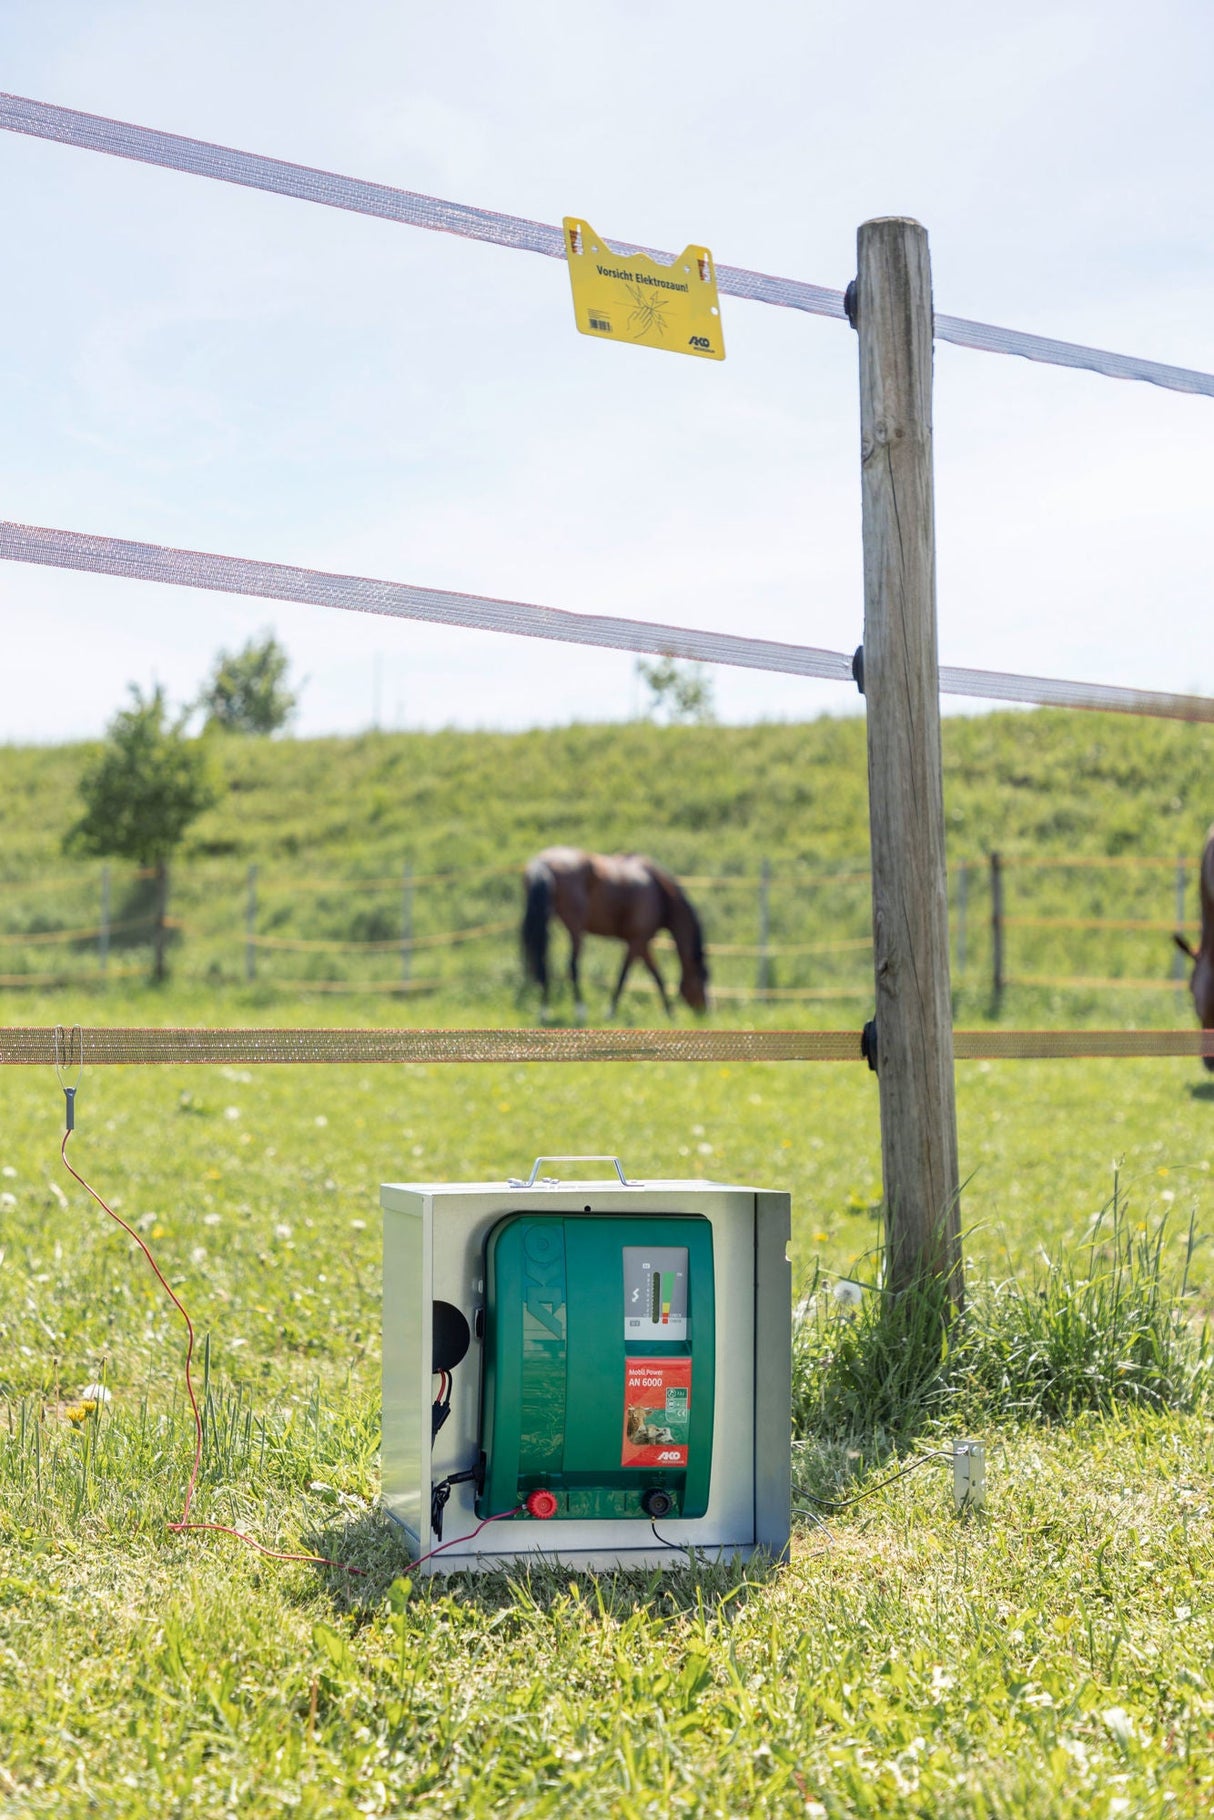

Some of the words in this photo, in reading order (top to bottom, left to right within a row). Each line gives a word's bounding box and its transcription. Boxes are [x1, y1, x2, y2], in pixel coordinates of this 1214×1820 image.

[596, 265, 633, 281] Vorsicht
[635, 273, 689, 293] Elektrozaun!
[688, 336, 710, 348] AKO
[524, 1223, 562, 1340] AKO
[629, 1378, 641, 1387] AN
[642, 1378, 663, 1387] 6000
[657, 1451, 681, 1461] AKO
